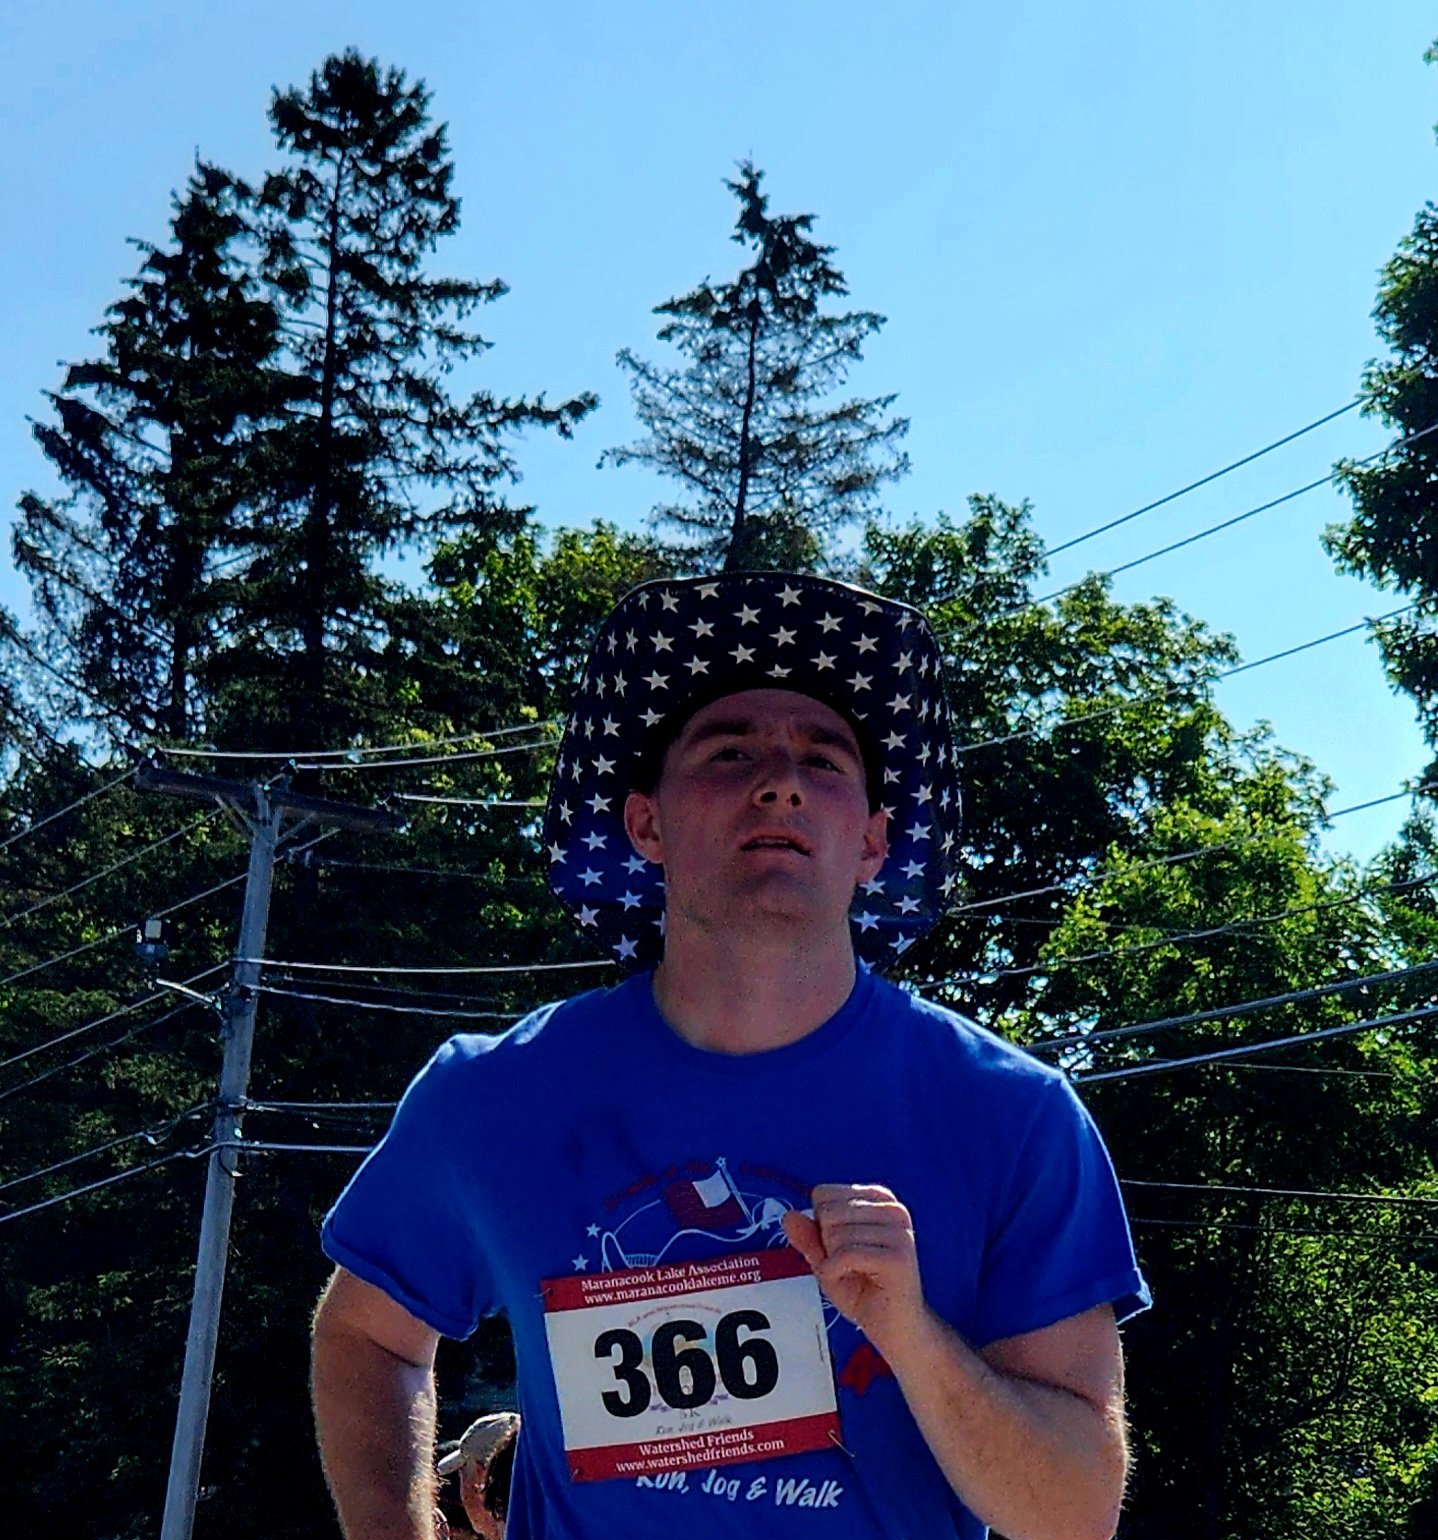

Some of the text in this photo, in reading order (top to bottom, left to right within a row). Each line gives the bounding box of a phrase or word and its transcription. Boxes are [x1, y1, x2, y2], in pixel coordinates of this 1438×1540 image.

[581, 1255, 761, 1293] Maranacook Lake Association
[584, 1269, 762, 1305] www.maranacooklakeme.org
[594, 1309, 780, 1418] 366
[616, 1438, 785, 1474] www.watershedfriends.com
[639, 1429, 755, 1457] Watershed Friends
[701, 1469, 740, 1502] Jog
[746, 1476, 767, 1501] &
[774, 1477, 844, 1508] Walk
